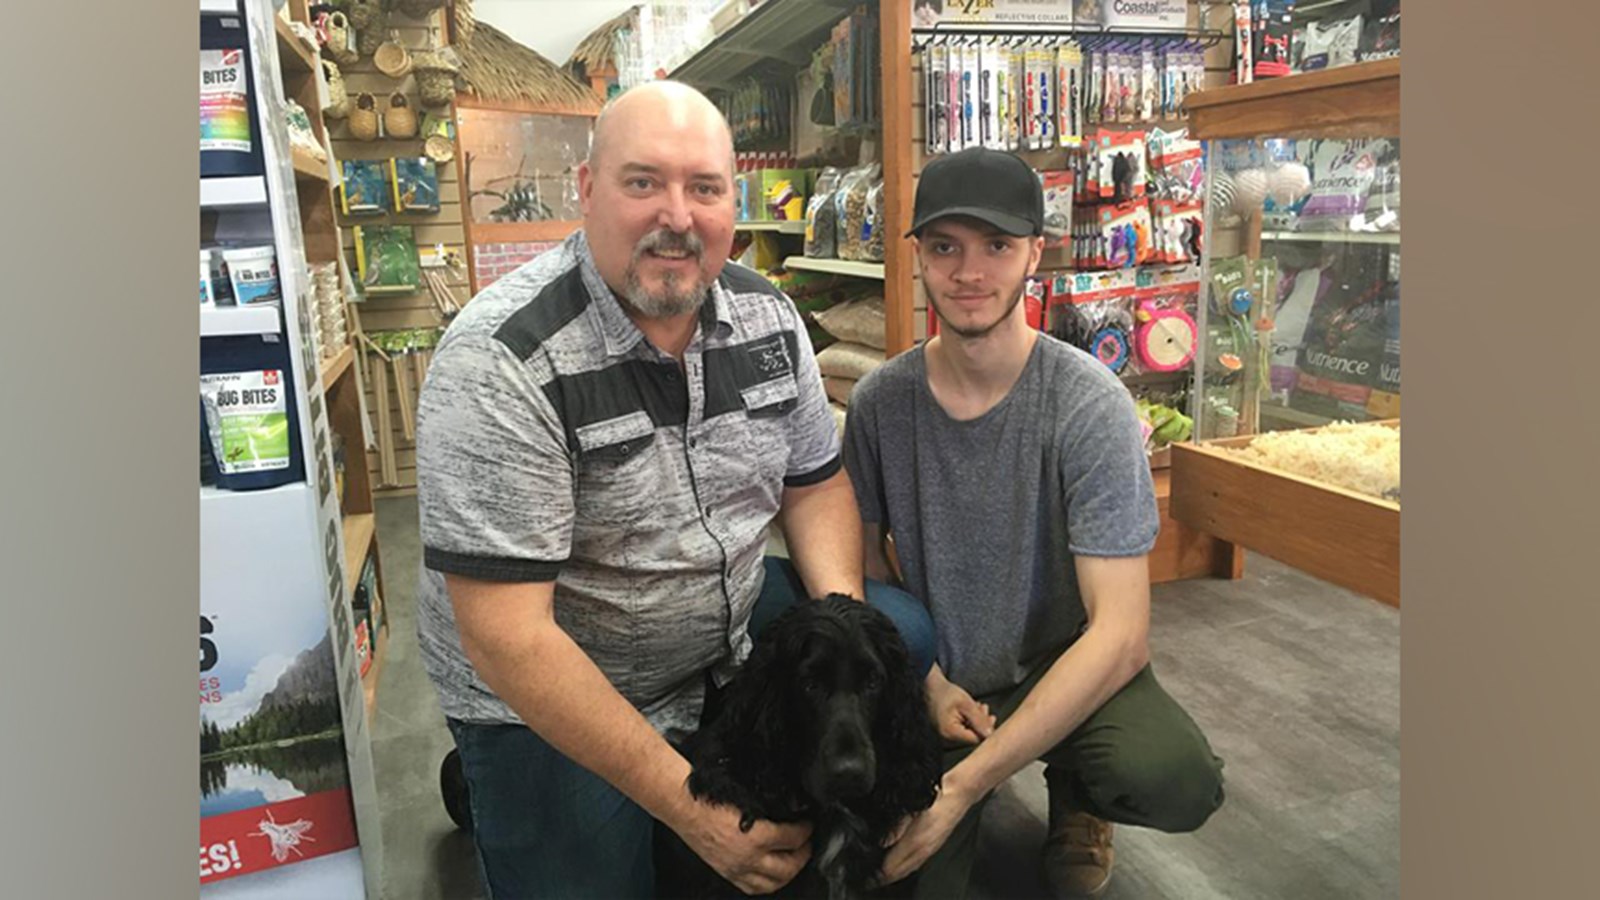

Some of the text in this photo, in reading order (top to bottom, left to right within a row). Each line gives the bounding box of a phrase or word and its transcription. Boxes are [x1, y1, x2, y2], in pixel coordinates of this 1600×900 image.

[1113, 0, 1158, 14] Coastal
[1037, 13, 1069, 21] COLLARS
[202, 67, 238, 86] BITES
[1306, 348, 1370, 376] Nutrience
[217, 388, 277, 407] BUG BITES
[200, 839, 242, 877] ES!
